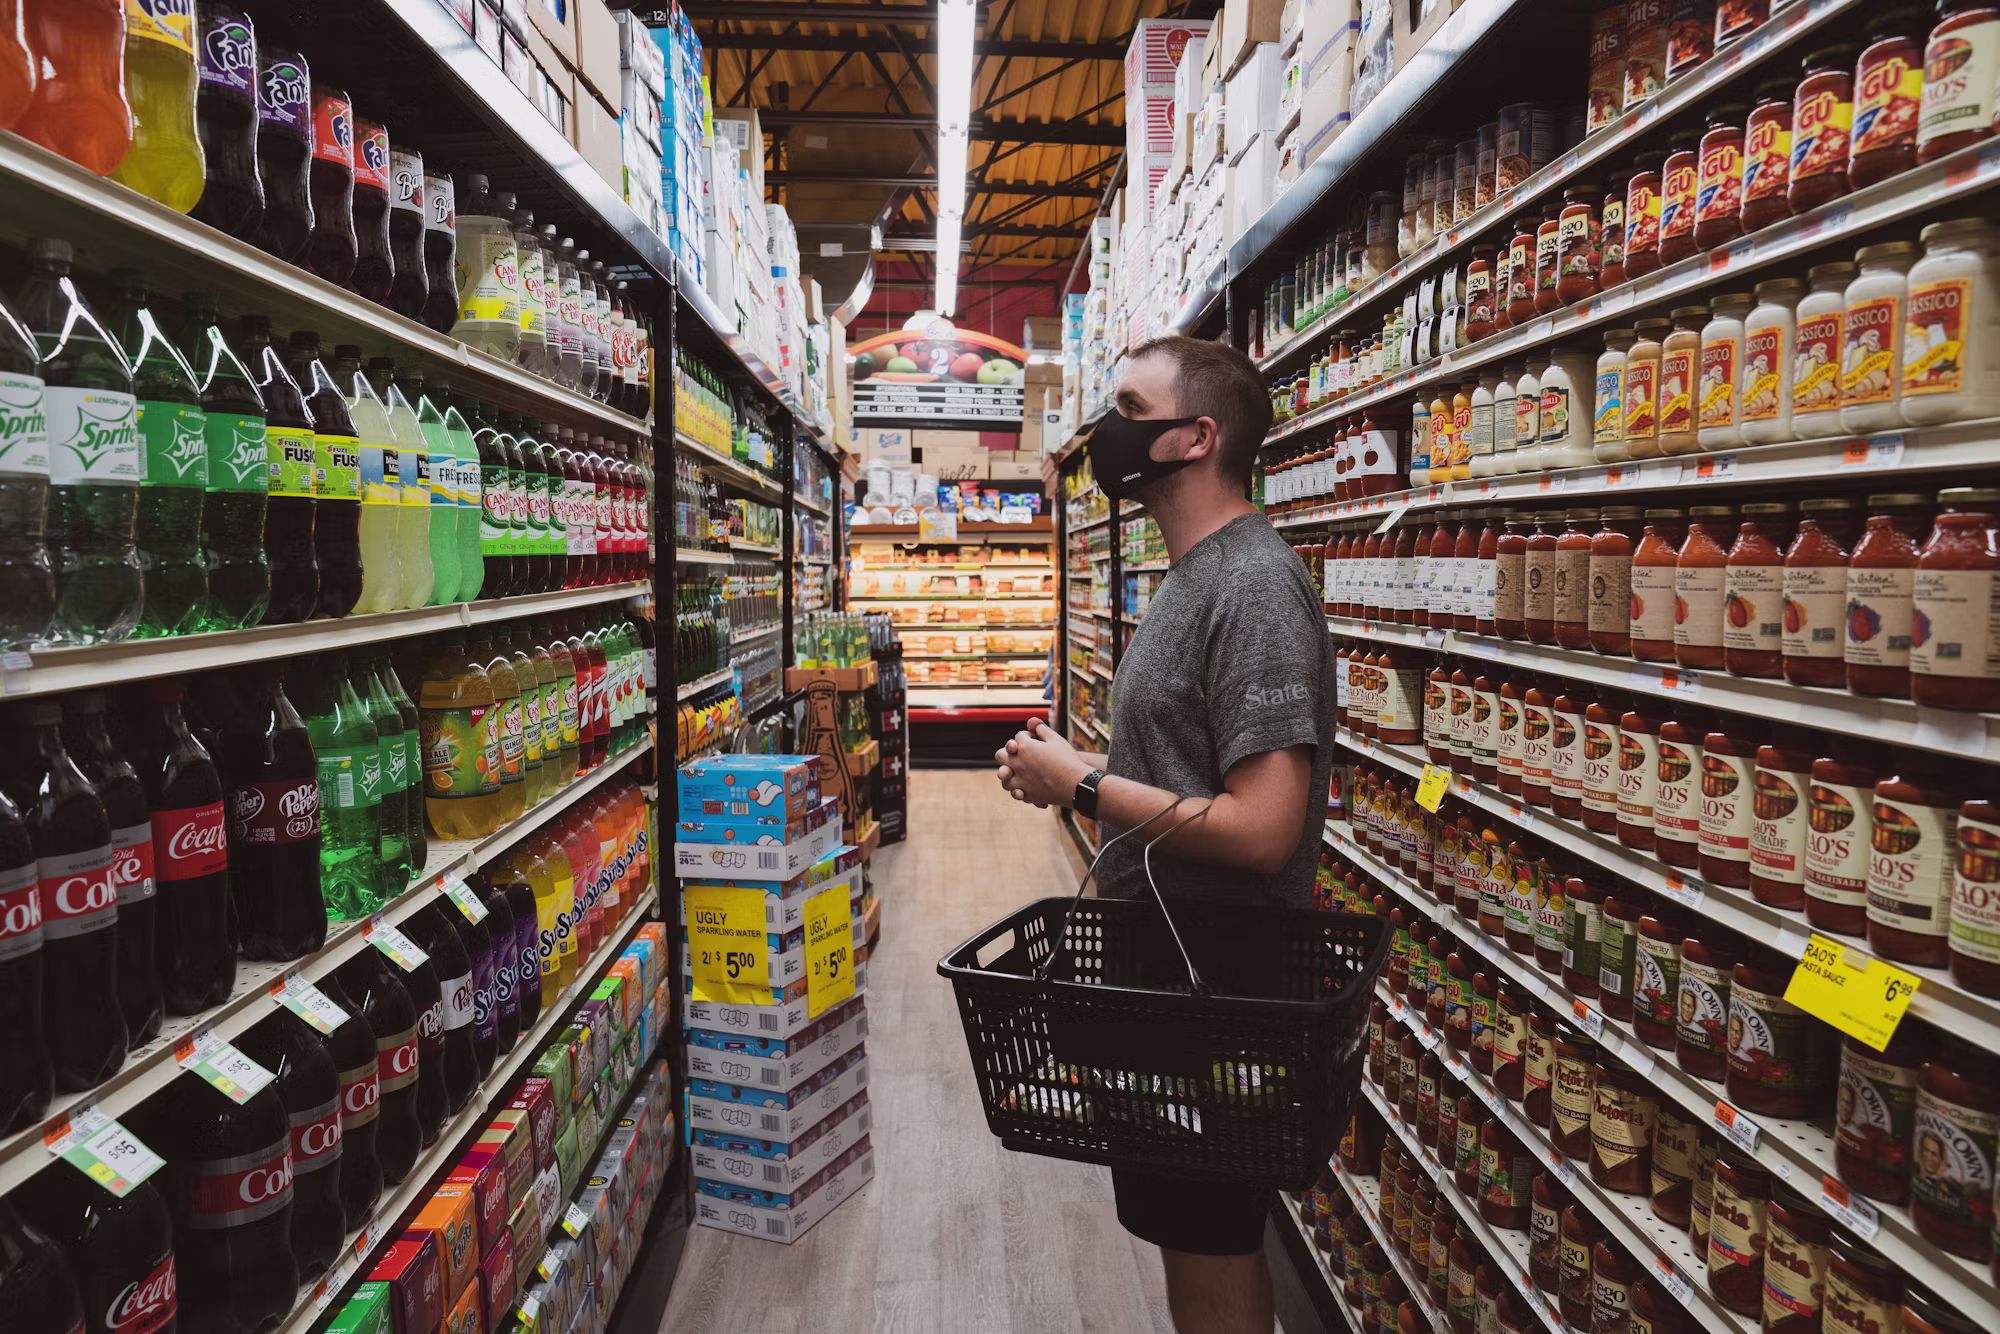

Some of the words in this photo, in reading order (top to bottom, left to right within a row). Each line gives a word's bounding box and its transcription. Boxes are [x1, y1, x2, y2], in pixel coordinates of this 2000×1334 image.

[930, 347, 951, 377] 2
[77, 421, 137, 451] Sprite
[1122, 472, 1141, 482] atoms
[298, 783, 313, 801] Dr
[1588, 791, 1610, 800] GARLIC
[1622, 804, 1643, 814] GARLIC
[295, 820, 306, 832] 23
[712, 850, 746, 868] ugly
[1816, 871, 1863, 888] MARINARA
[696, 911, 727, 925] UGLY
[809, 916, 828, 936] UGLY
[697, 926, 734, 937] SPARKLING
[736, 929, 761, 938] WATER
[810, 930, 834, 946] SPARKLING
[833, 922, 849, 936] WATER
[1645, 942, 1669, 955] Charity
[1805, 943, 1837, 966] RAO'S
[702, 952, 712, 965] 2/
[716, 953, 721, 962] $
[1646, 962, 1662, 991] OWN
[1699, 969, 1730, 983] Charity
[1798, 959, 1821, 976] PASTA
[1822, 968, 1846, 987] SAUCE
[1701, 991, 1722, 1021] OWN
[719, 1007, 749, 1026] ugly
[1748, 1016, 1769, 1051] OWN
[721, 1061, 751, 1080] ugly
[1558, 1080, 1590, 1097] Organic
[1861, 1086, 1885, 1126] OWN
[721, 1107, 751, 1127] ugly
[723, 1157, 753, 1177] ugly
[1952, 1136, 1986, 1182] OWN
[728, 1210, 757, 1231] ugly
